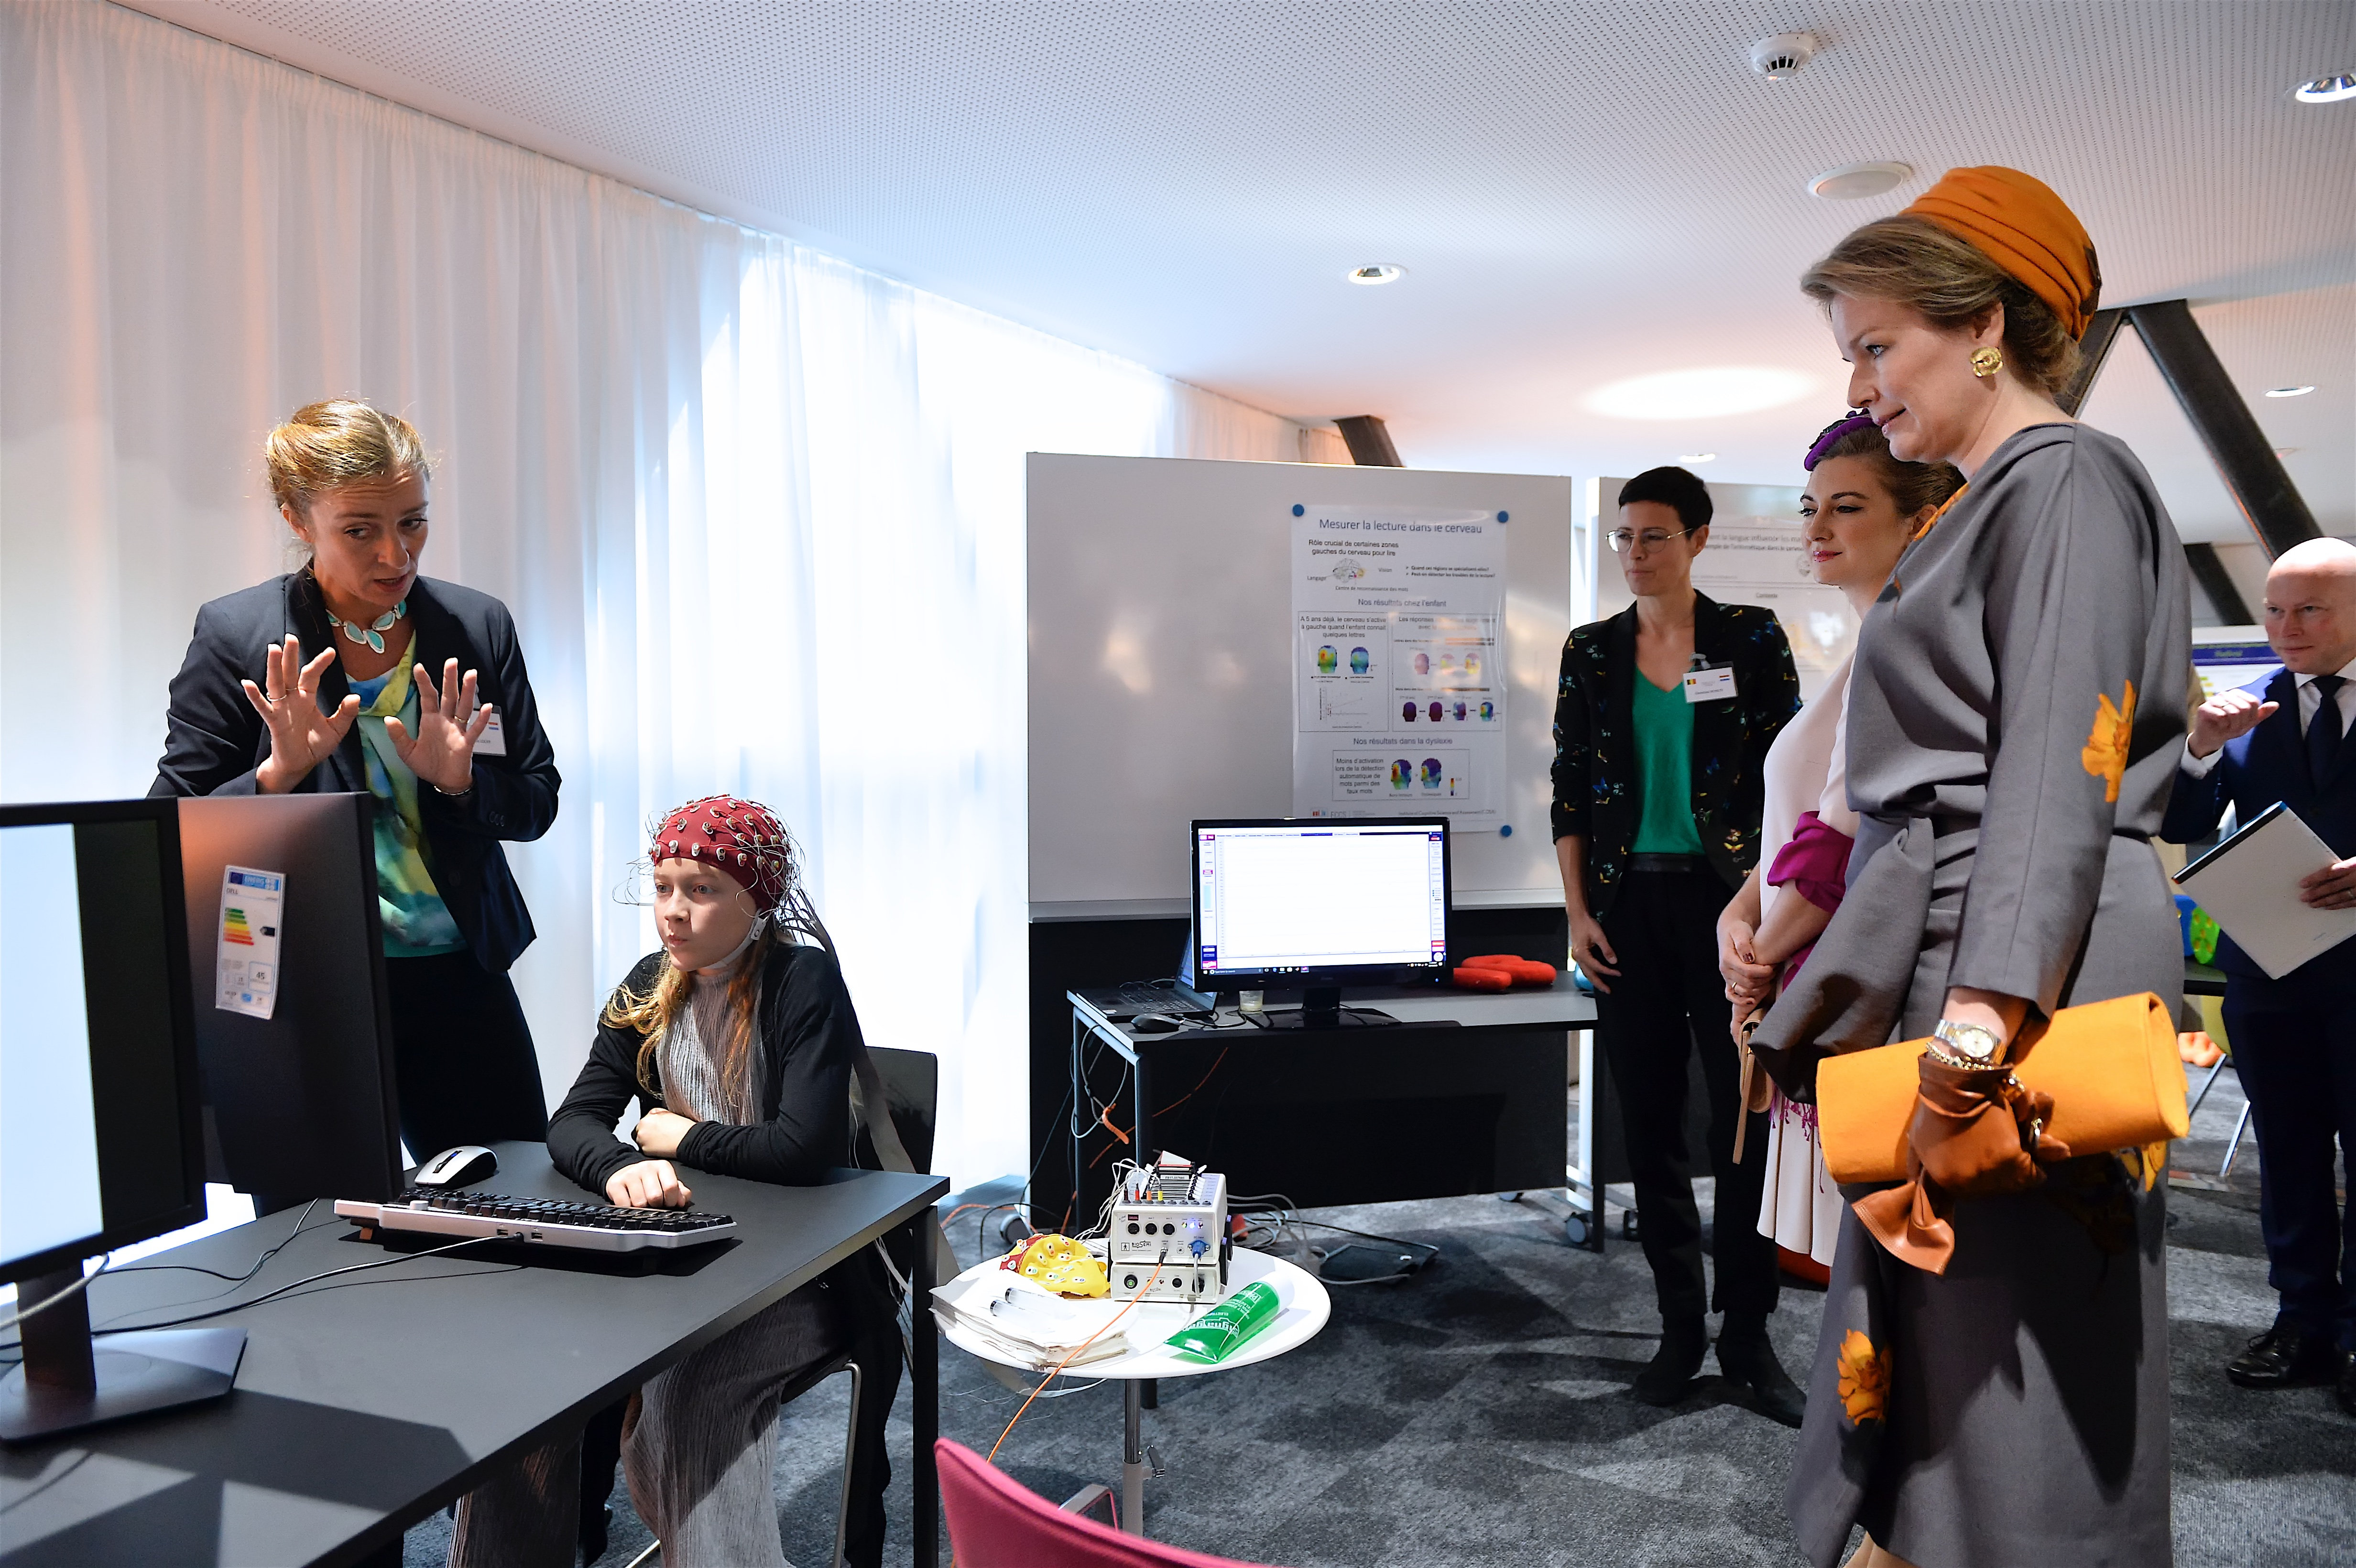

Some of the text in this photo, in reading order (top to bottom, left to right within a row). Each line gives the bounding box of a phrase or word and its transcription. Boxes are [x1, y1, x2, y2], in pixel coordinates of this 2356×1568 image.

[1320, 519, 1482, 533] Mesurer la lecture dans le cerveau
